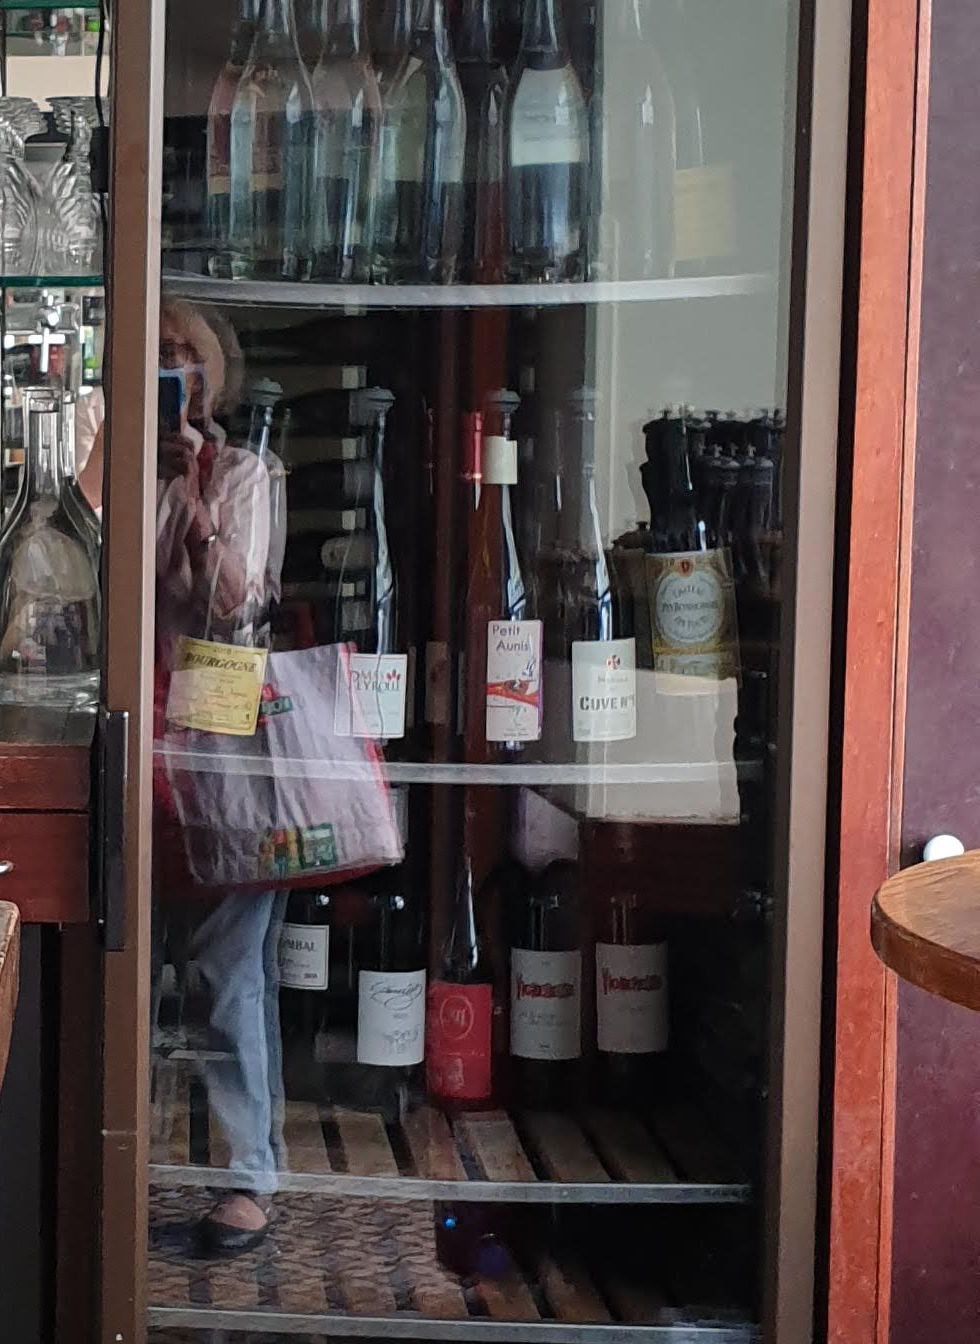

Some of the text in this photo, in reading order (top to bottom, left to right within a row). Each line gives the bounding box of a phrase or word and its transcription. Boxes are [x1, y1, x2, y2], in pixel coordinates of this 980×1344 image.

[492, 624, 520, 637] Petit
[496, 639, 529, 651] Aunis
[184, 653, 257, 673] BOURGOGNE
